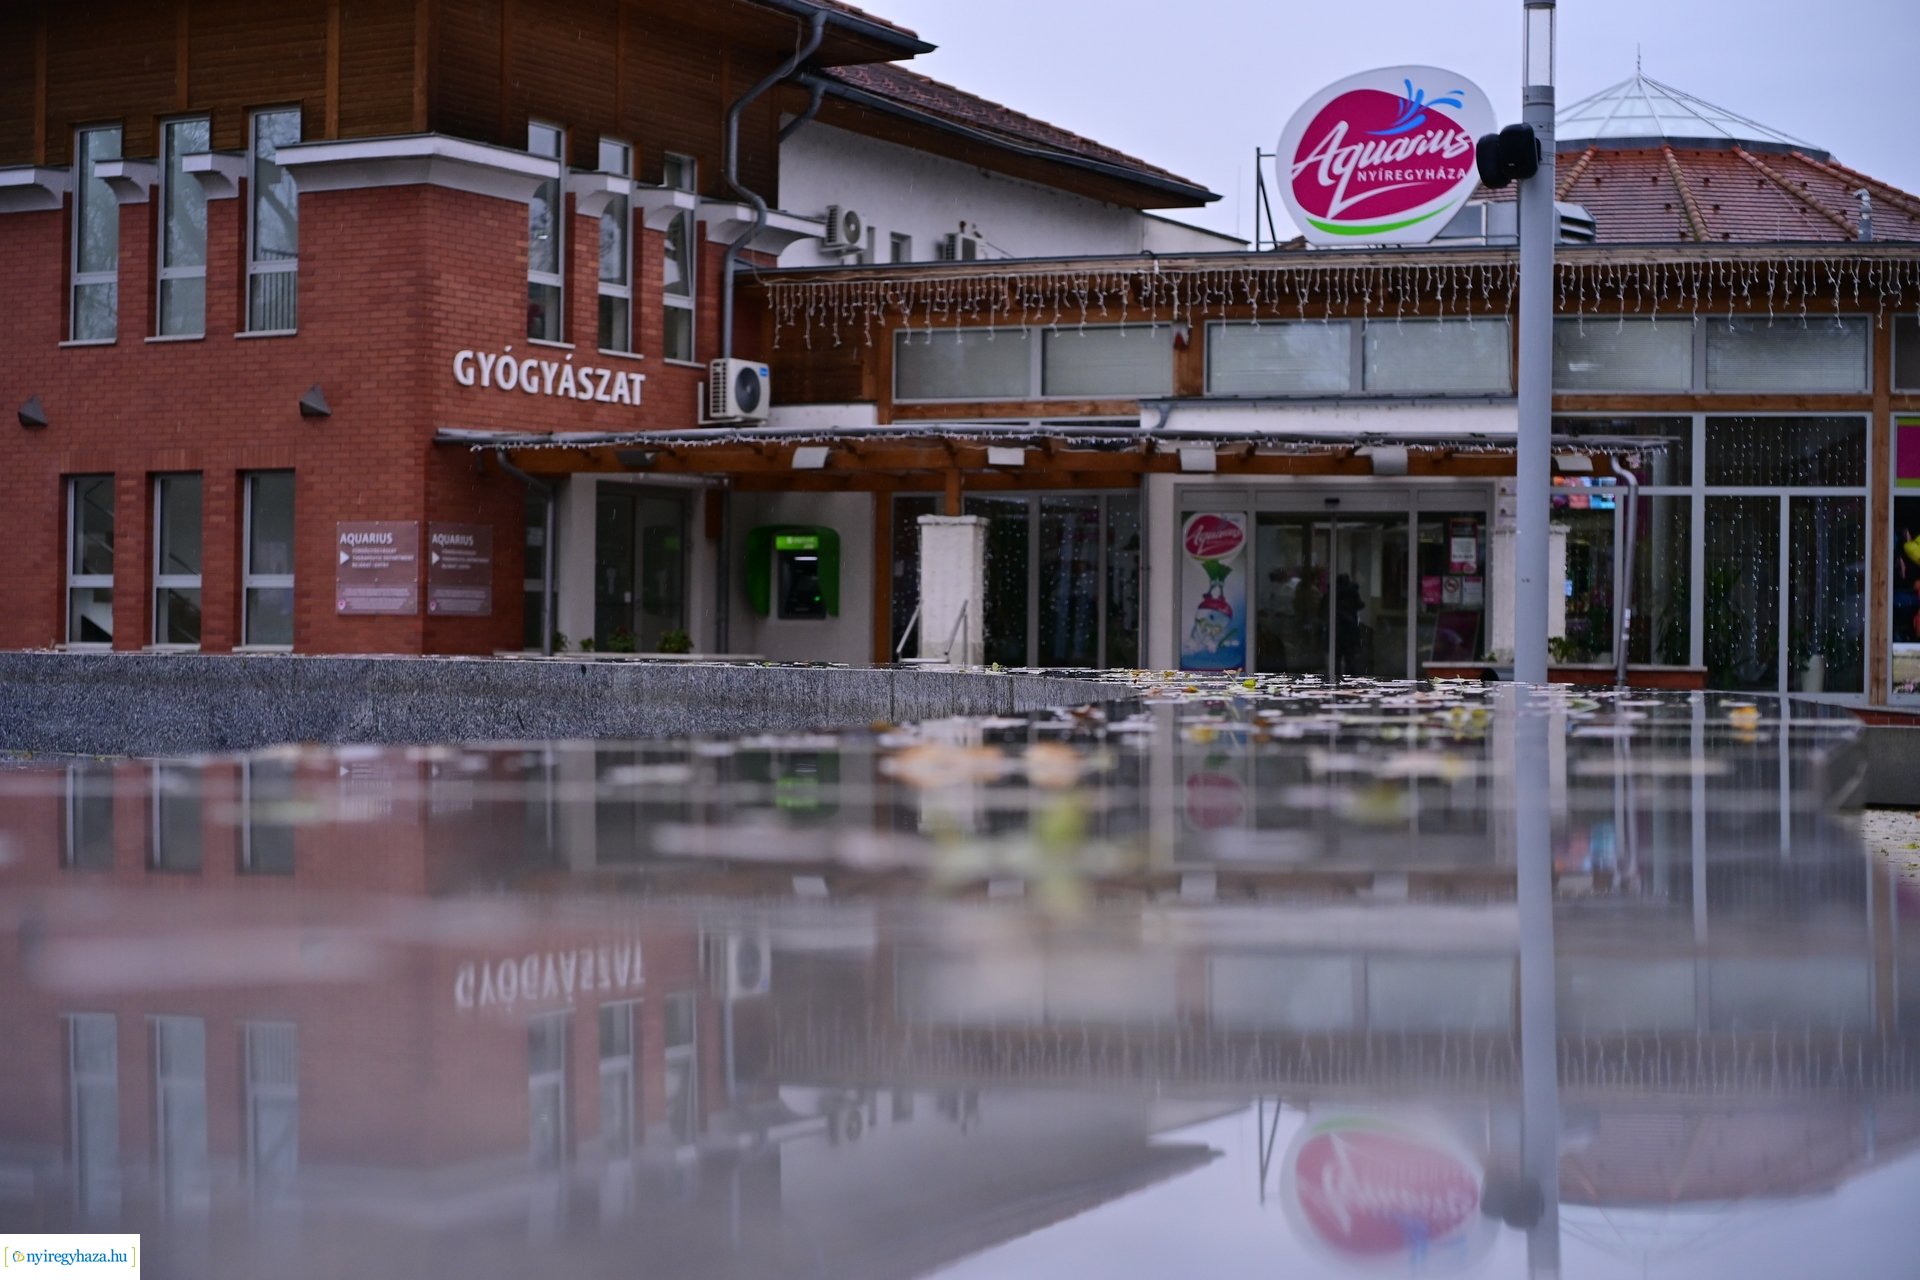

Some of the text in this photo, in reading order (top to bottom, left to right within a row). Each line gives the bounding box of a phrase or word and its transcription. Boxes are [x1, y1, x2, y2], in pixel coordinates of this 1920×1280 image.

[1290, 120, 1472, 220] Aquarius
[1357, 165, 1468, 182] NYÍREGYHÁZA
[453, 345, 646, 406] GYÓGYÁSZAT
[340, 532, 393, 547] AQUARIUS
[432, 533, 474, 547] AQUARIUS
